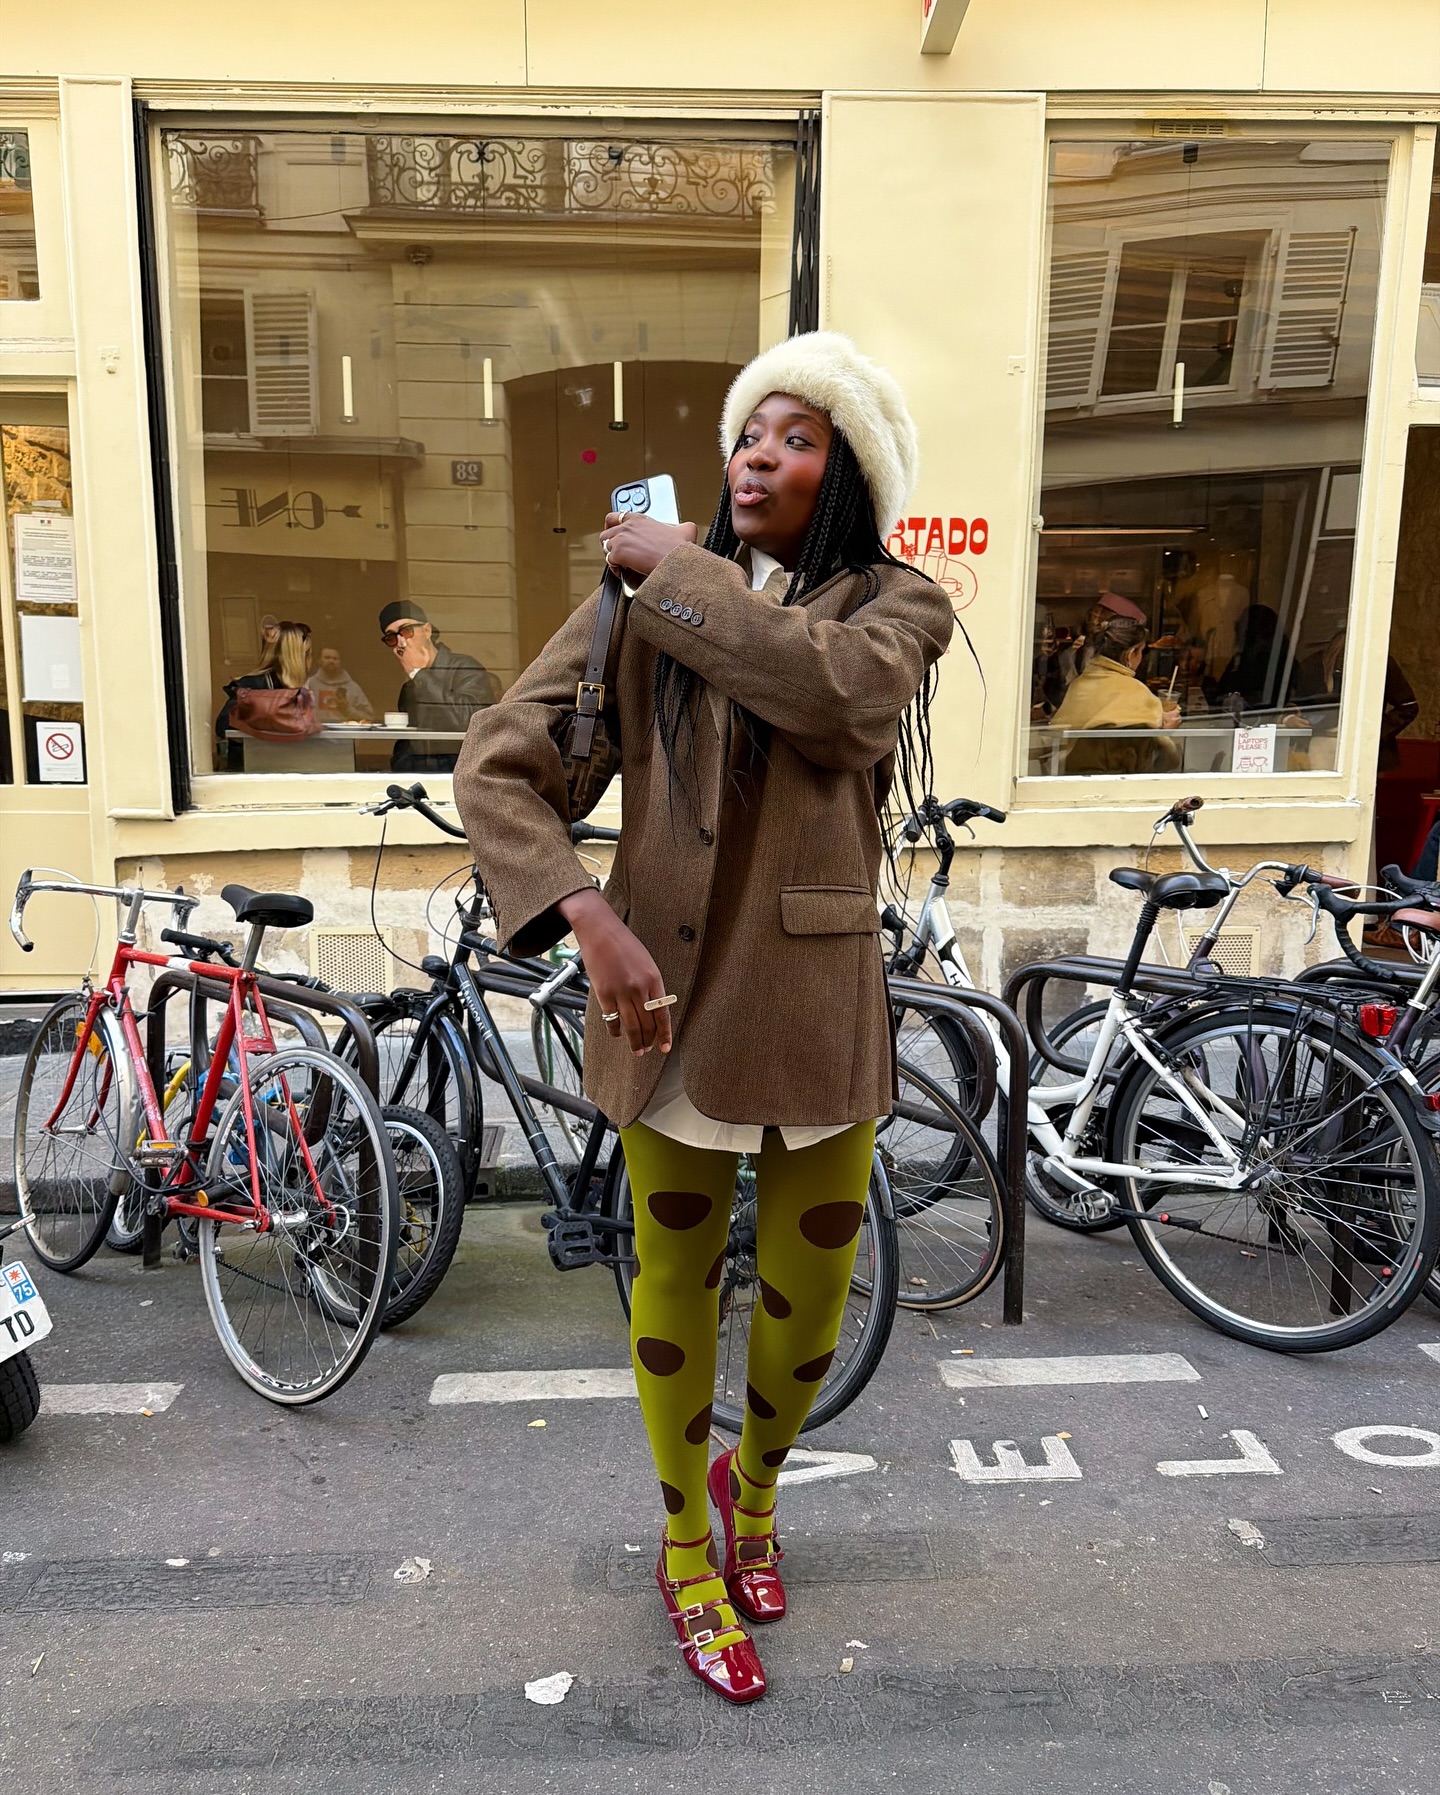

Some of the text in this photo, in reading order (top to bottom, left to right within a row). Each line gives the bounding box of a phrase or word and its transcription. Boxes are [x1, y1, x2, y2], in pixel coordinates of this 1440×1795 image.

[463, 990, 486, 1032] BALMORAL
[13, 1281, 34, 1301] 75
[0, 1309, 35, 1343] TD
